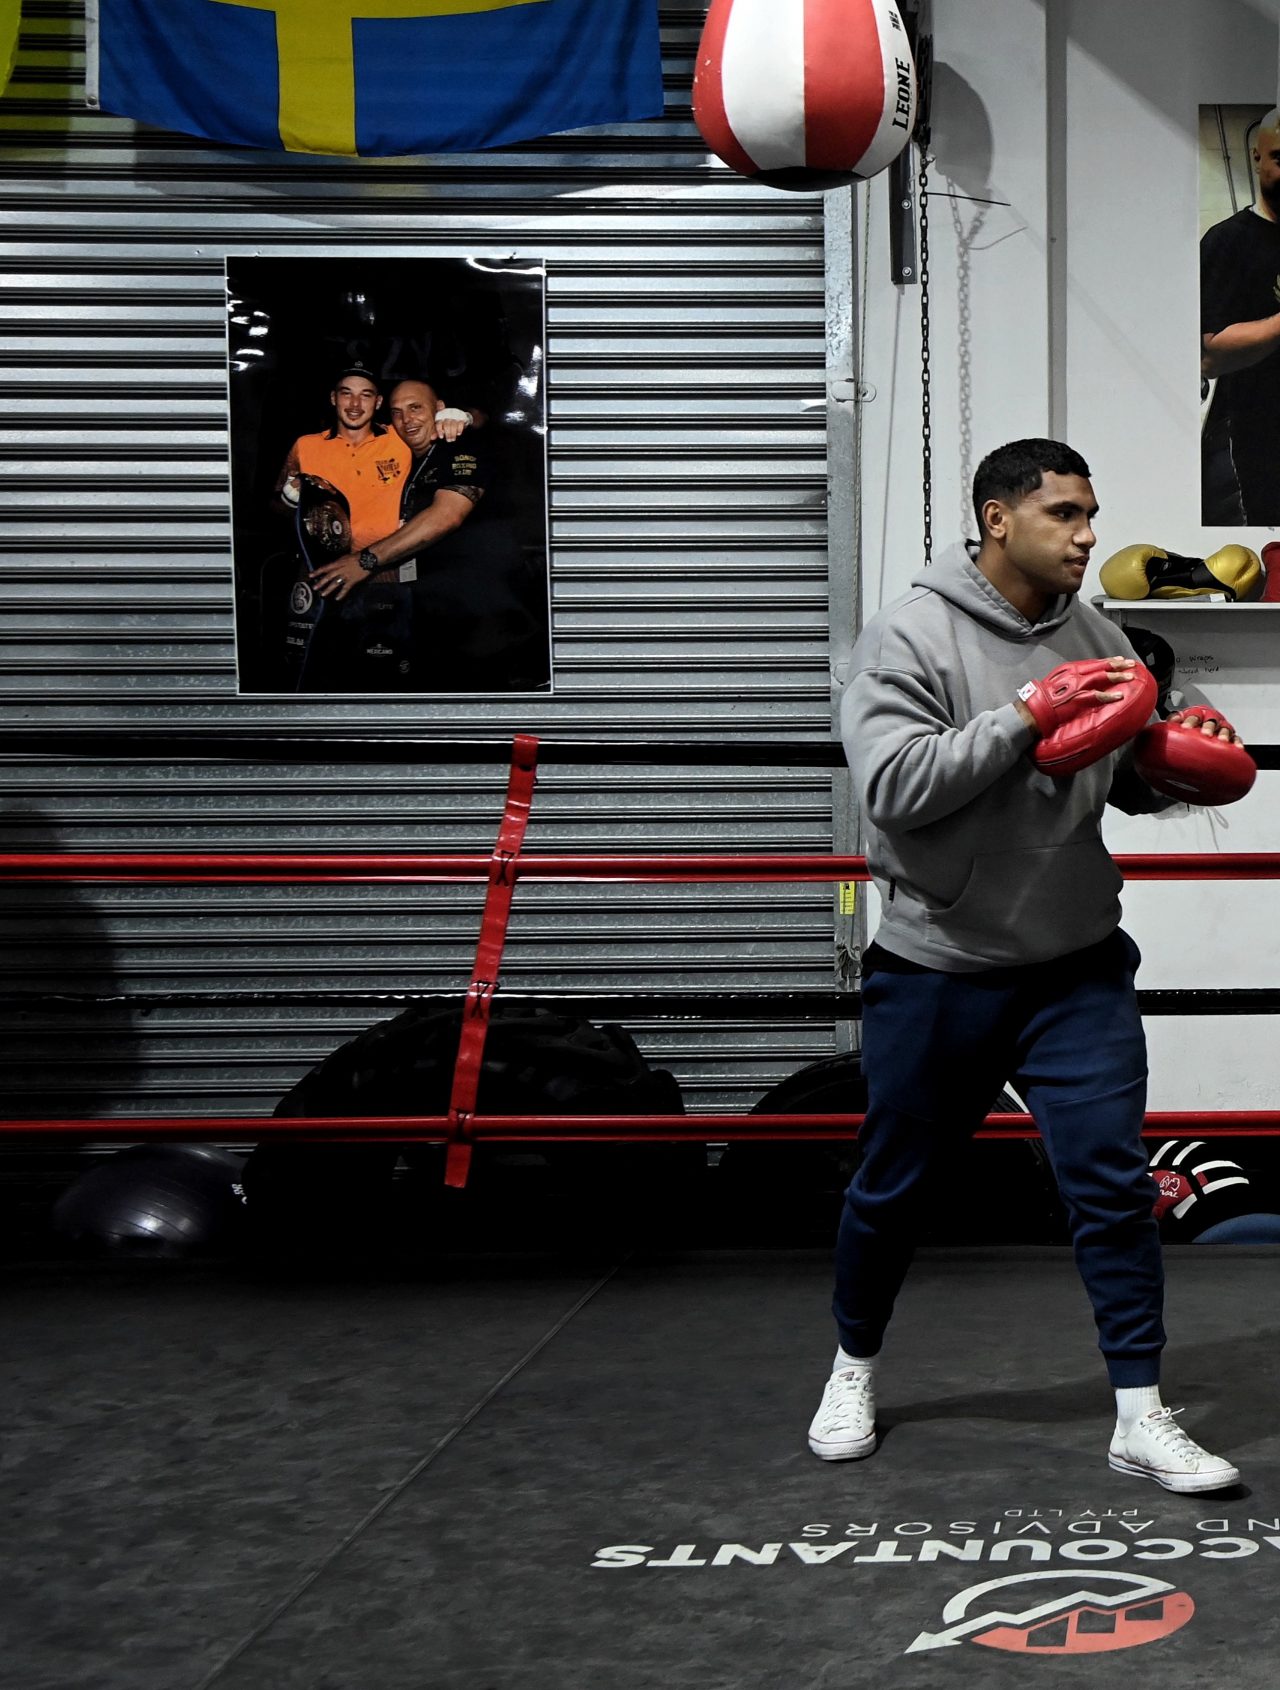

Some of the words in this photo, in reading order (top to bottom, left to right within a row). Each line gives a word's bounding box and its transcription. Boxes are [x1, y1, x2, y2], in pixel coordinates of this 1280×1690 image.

[892, 57, 910, 131] LEONE
[1004, 1508, 1062, 1518] LTD
[1079, 1508, 1137, 1517] PTY
[802, 1519, 1155, 1537] ADVISORS
